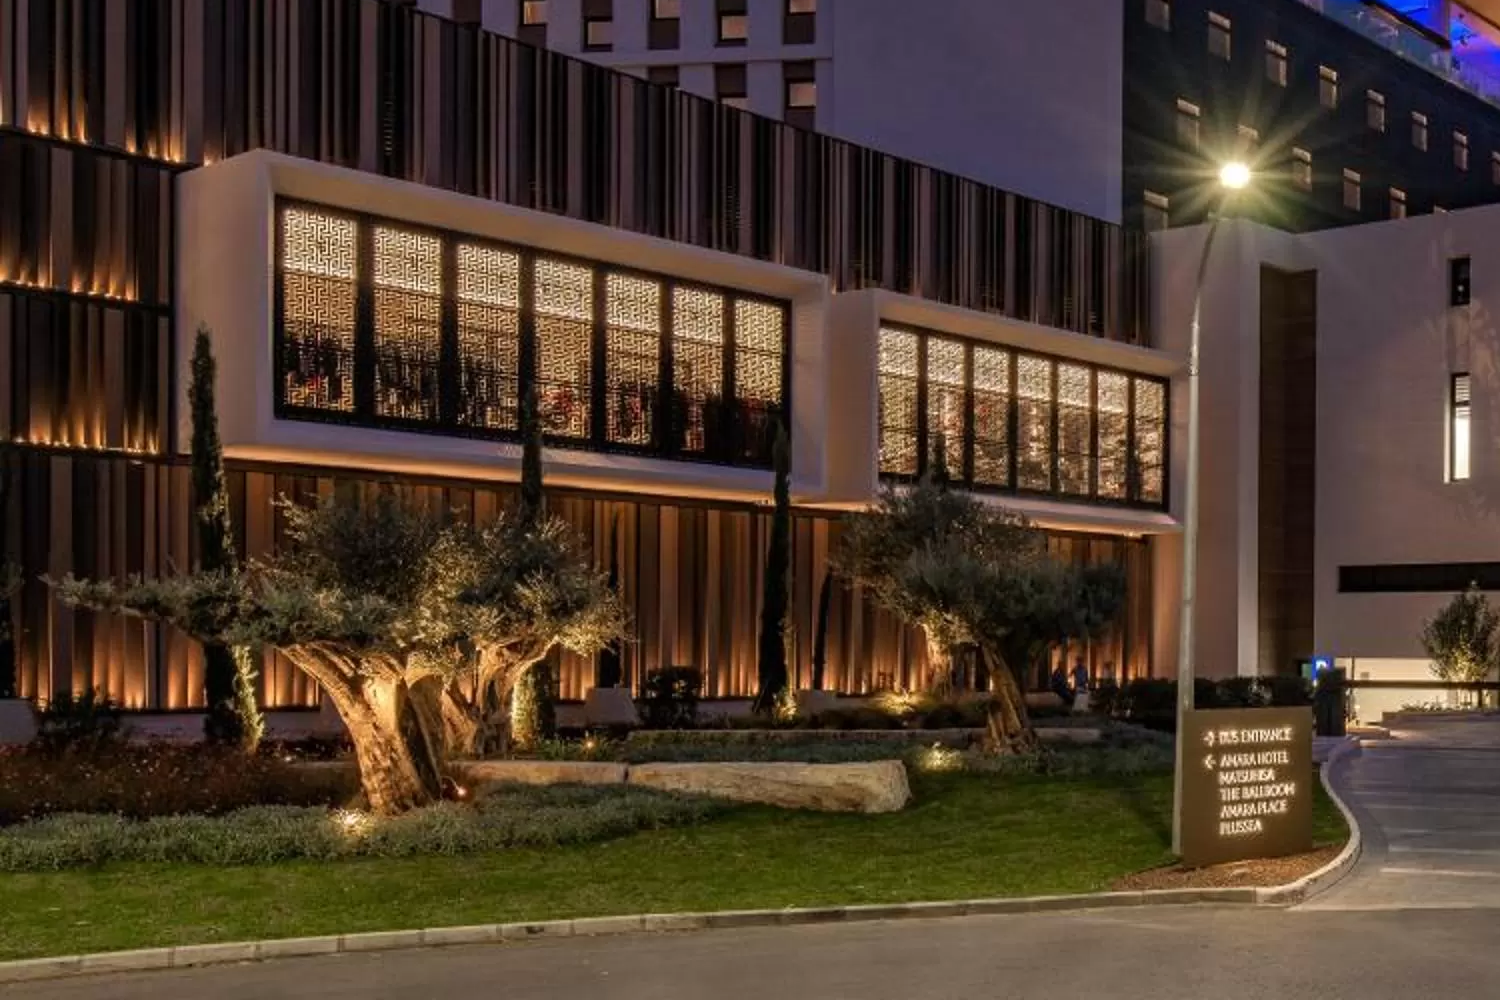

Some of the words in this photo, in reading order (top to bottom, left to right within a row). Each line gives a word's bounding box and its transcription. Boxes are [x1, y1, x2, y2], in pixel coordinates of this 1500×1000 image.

[1219, 730, 1239, 744] BUS
[1241, 727, 1292, 742] ENTRANCE
[1220, 753, 1256, 768] AMARA
[1257, 751, 1289, 765] HOTEL
[1219, 787, 1240, 801] THE
[1241, 783, 1295, 799] BALLROOM
[1220, 803, 1256, 818] AMARA
[1257, 800, 1288, 814] PLACE
